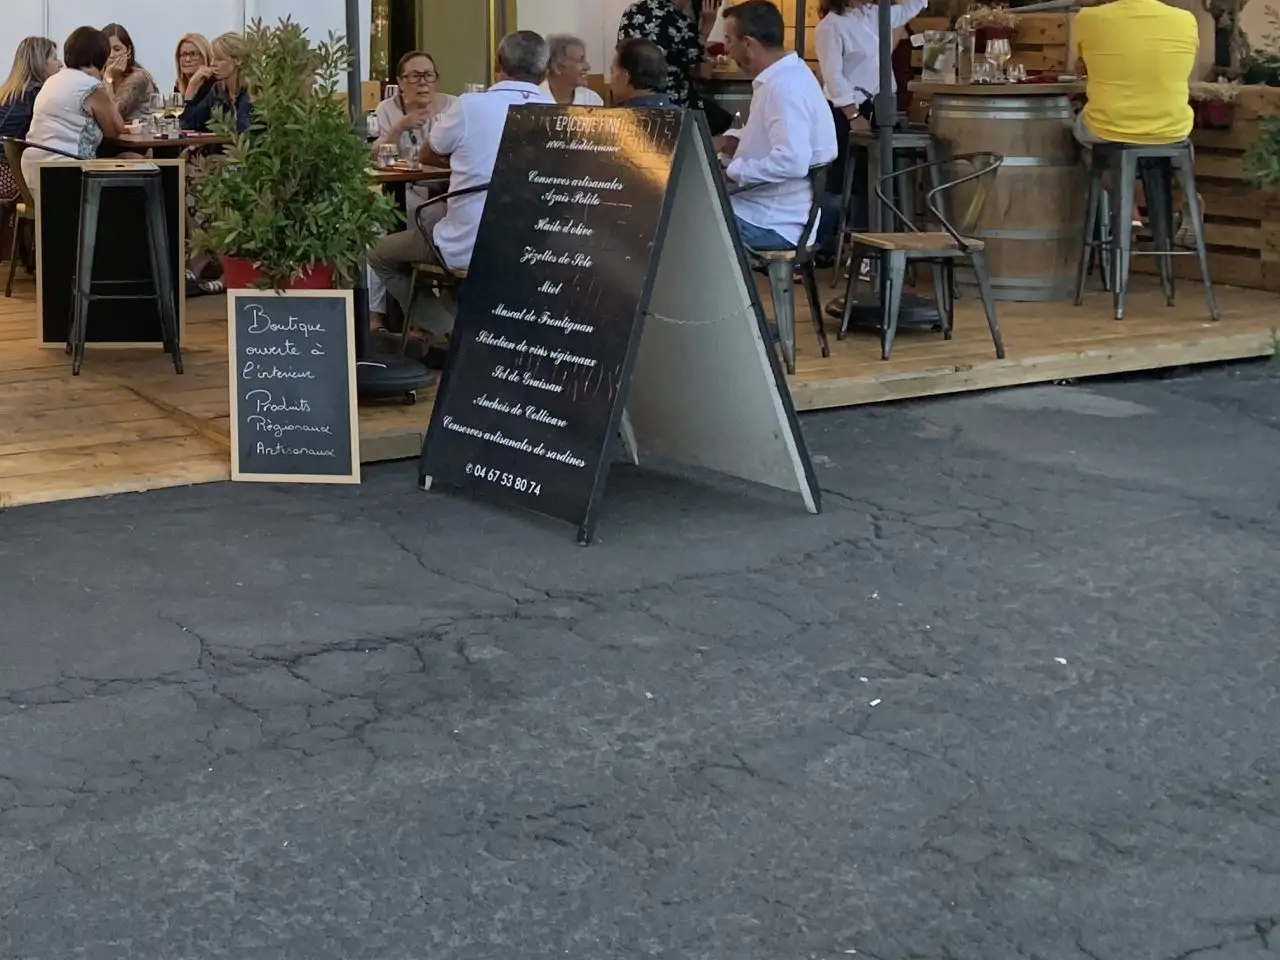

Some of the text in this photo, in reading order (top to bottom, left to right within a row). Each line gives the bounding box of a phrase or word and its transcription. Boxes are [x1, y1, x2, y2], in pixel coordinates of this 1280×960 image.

[527, 169, 624, 191] Conserves artisanales
[533, 217, 562, 233] Huile
[558, 251, 570, 265] de
[537, 279, 564, 295] Miel
[244, 303, 326, 338] Boutique
[491, 302, 595, 335] Muscat de Frontignan
[245, 340, 325, 356] ouverte à
[475, 329, 598, 368] Sélection de vins régionaux
[491, 364, 564, 393] Sel de Gruissan
[245, 389, 311, 413] Produits
[472, 393, 569, 429] Anchois de Collioure
[256, 440, 337, 457] Artisanaux
[442, 414, 587, 468] Conserves artisanales de sardines
[473, 464, 542, 496] 04 67 53 80 74
